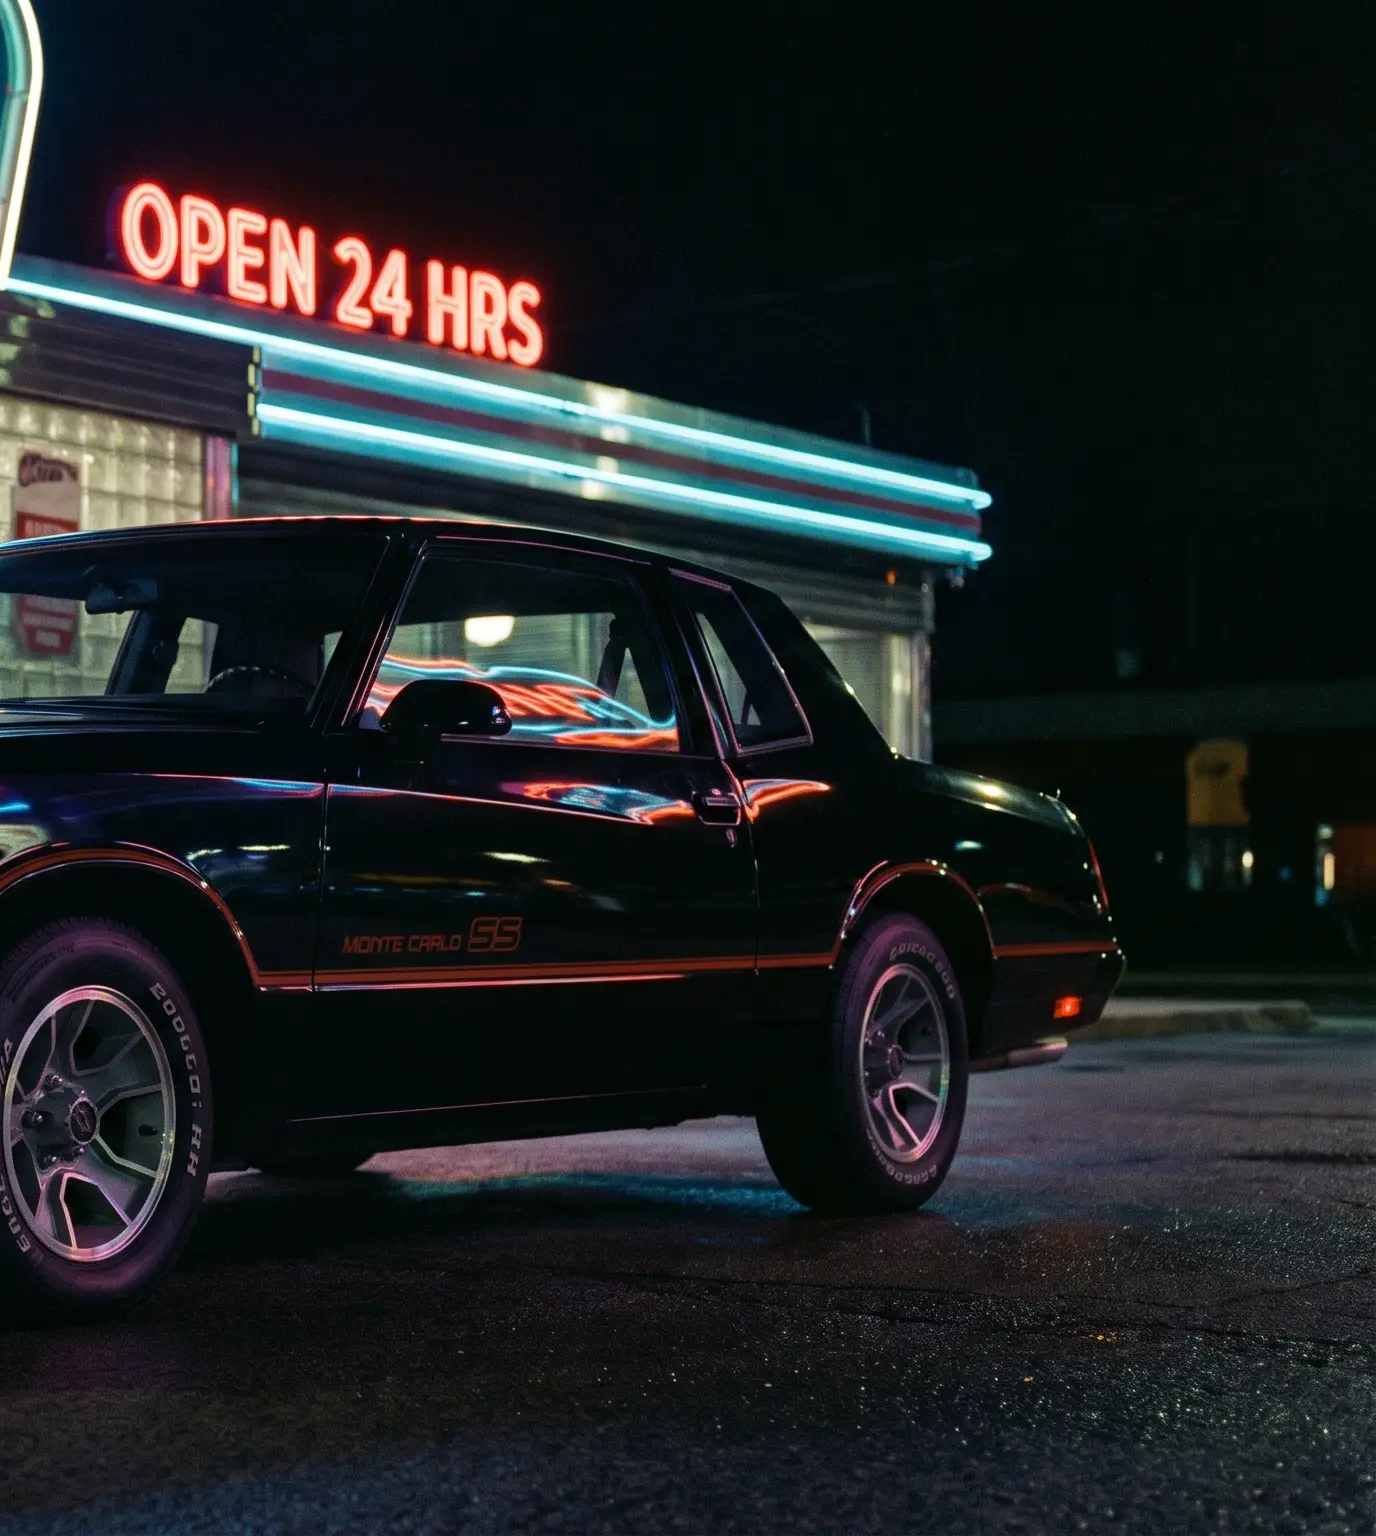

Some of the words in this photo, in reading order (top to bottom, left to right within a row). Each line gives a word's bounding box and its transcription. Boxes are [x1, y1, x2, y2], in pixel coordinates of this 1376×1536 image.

[121, 182, 316, 316] OPEN
[333, 236, 413, 337] 24
[427, 259, 543, 366] HRS
[342, 935, 405, 954] MONTE
[407, 934, 463, 952] CARLO
[467, 916, 523, 953] SS
